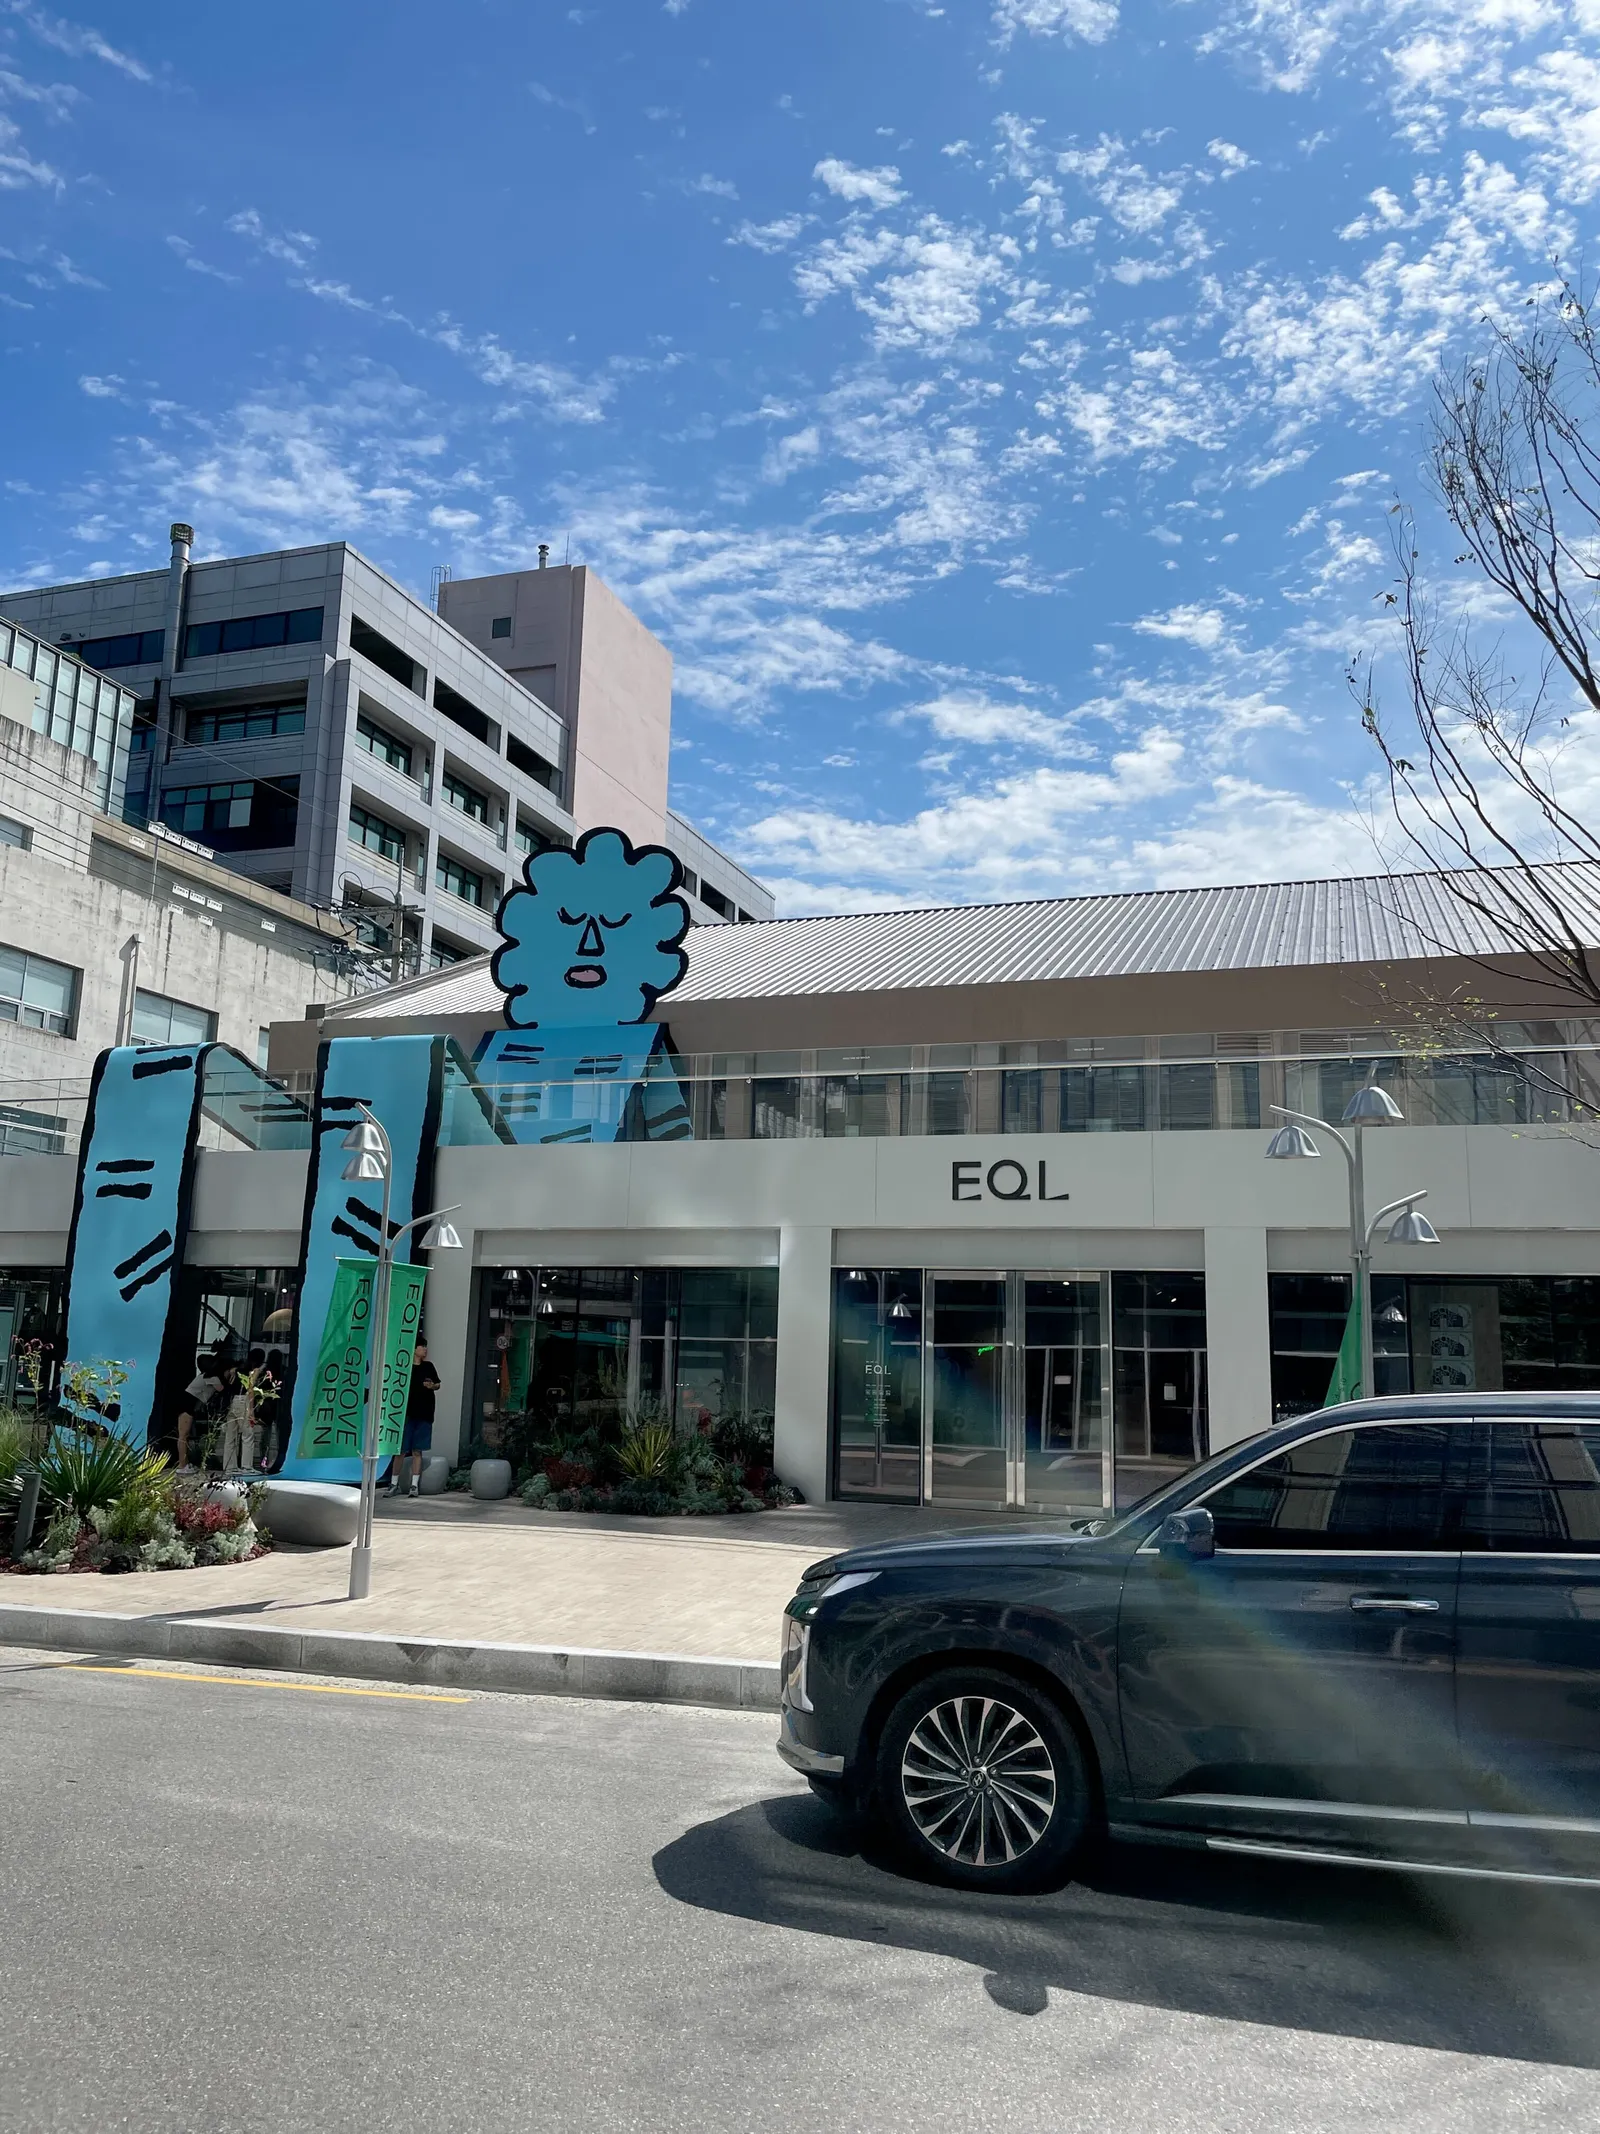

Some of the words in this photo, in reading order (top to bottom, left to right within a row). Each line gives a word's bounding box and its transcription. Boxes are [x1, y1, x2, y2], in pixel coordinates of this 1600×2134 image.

[952, 1159, 1070, 1201] EQL
[865, 1364, 892, 1375] EQL
[312, 1363, 340, 1445] OPEN
